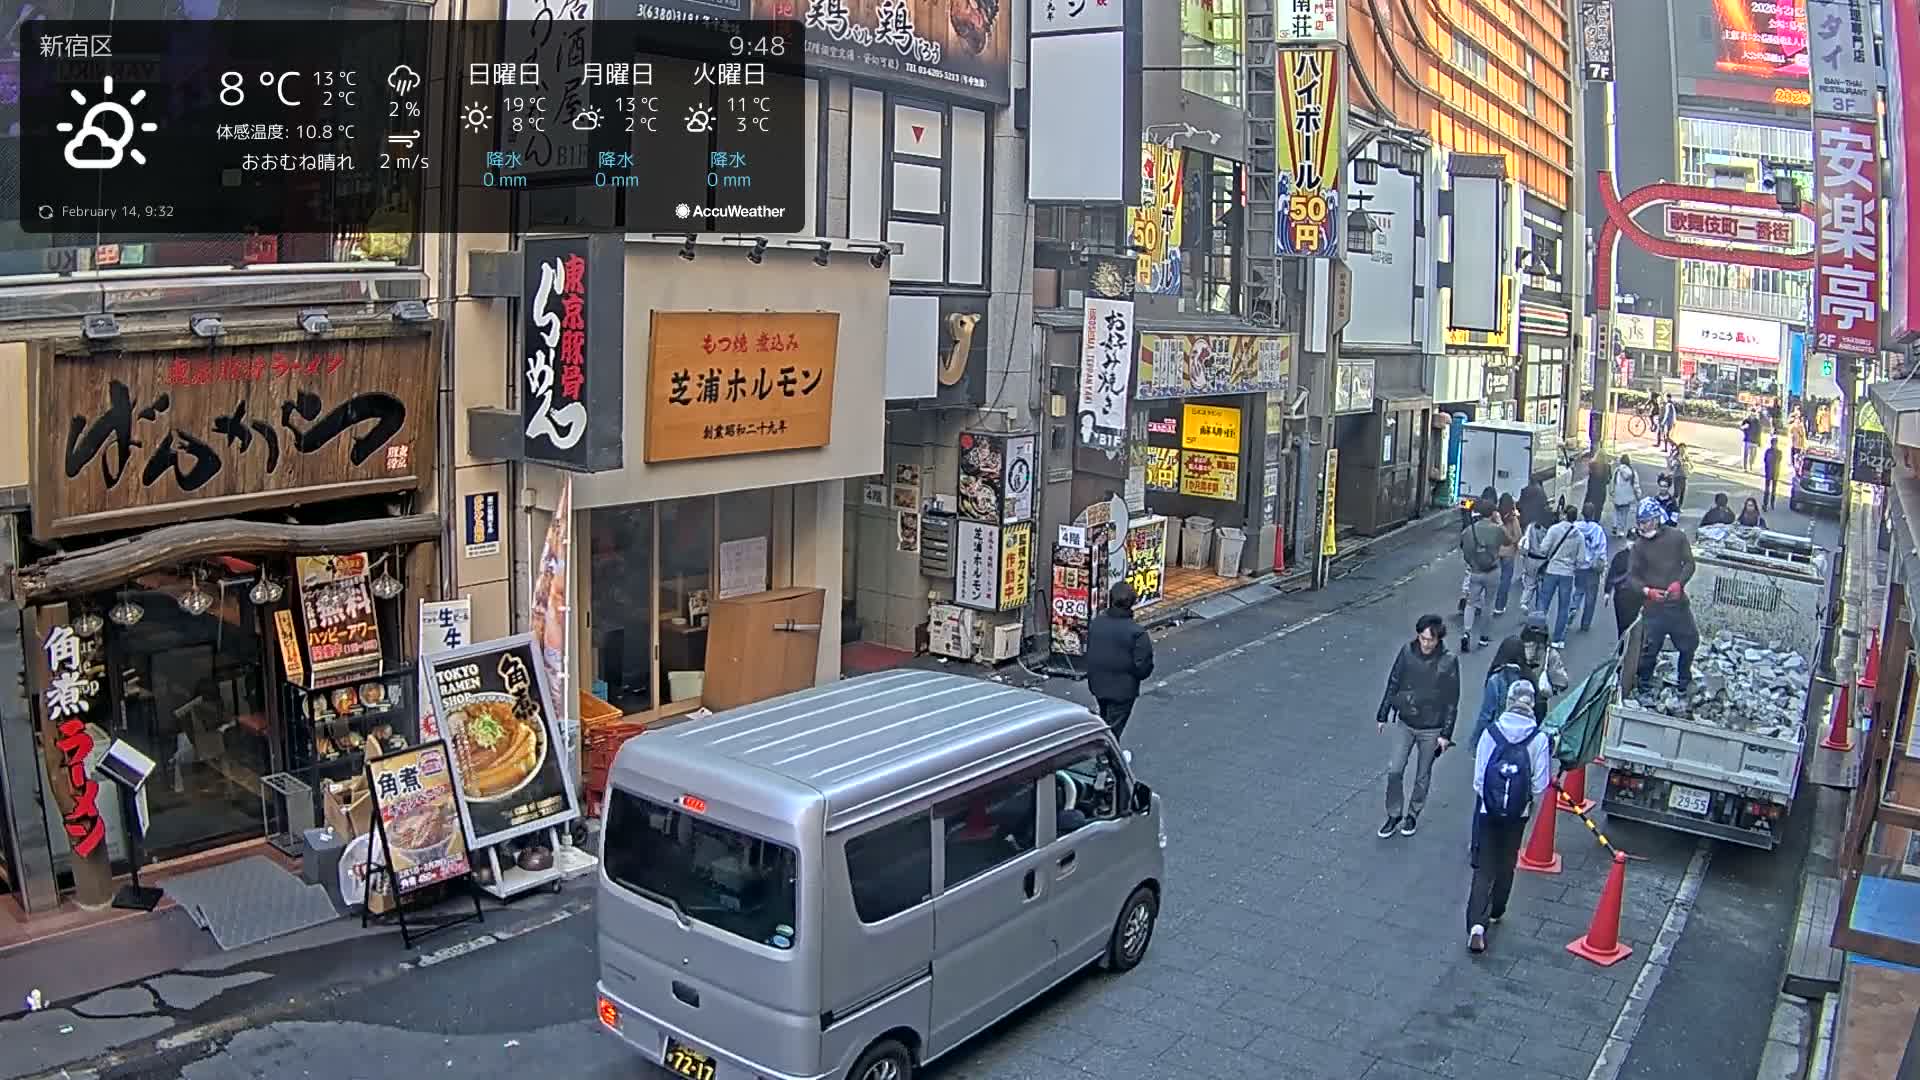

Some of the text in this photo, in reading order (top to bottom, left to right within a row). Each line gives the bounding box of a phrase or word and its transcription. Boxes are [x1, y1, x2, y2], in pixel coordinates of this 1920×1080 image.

[1588, 63, 1610, 79] 7F
[1832, 97, 1856, 112] 3F
[1295, 54, 1322, 192] ハイボール
[1289, 197, 1327, 223] 50
[1296, 225, 1319, 251] 円
[1670, 212, 1791, 242] 歌舞伎町一番街
[1820, 127, 1876, 330] 安楽亭
[559, 253, 587, 401] 東京豚骨
[703, 331, 800, 354] もつ焼 煮込み
[1818, 333, 1837, 347] 2F
[1099, 309, 1127, 415] お好み焼き
[669, 366, 823, 405] 芝浦ホルモン
[1061, 532, 1081, 546] 4階
[435, 663, 479, 684] TOKYO
[439, 677, 481, 695] RAMEN
[442, 692, 472, 708] SHOP
[377, 766, 421, 800] 角煮
[1678, 796, 1707, 812] 29-55
